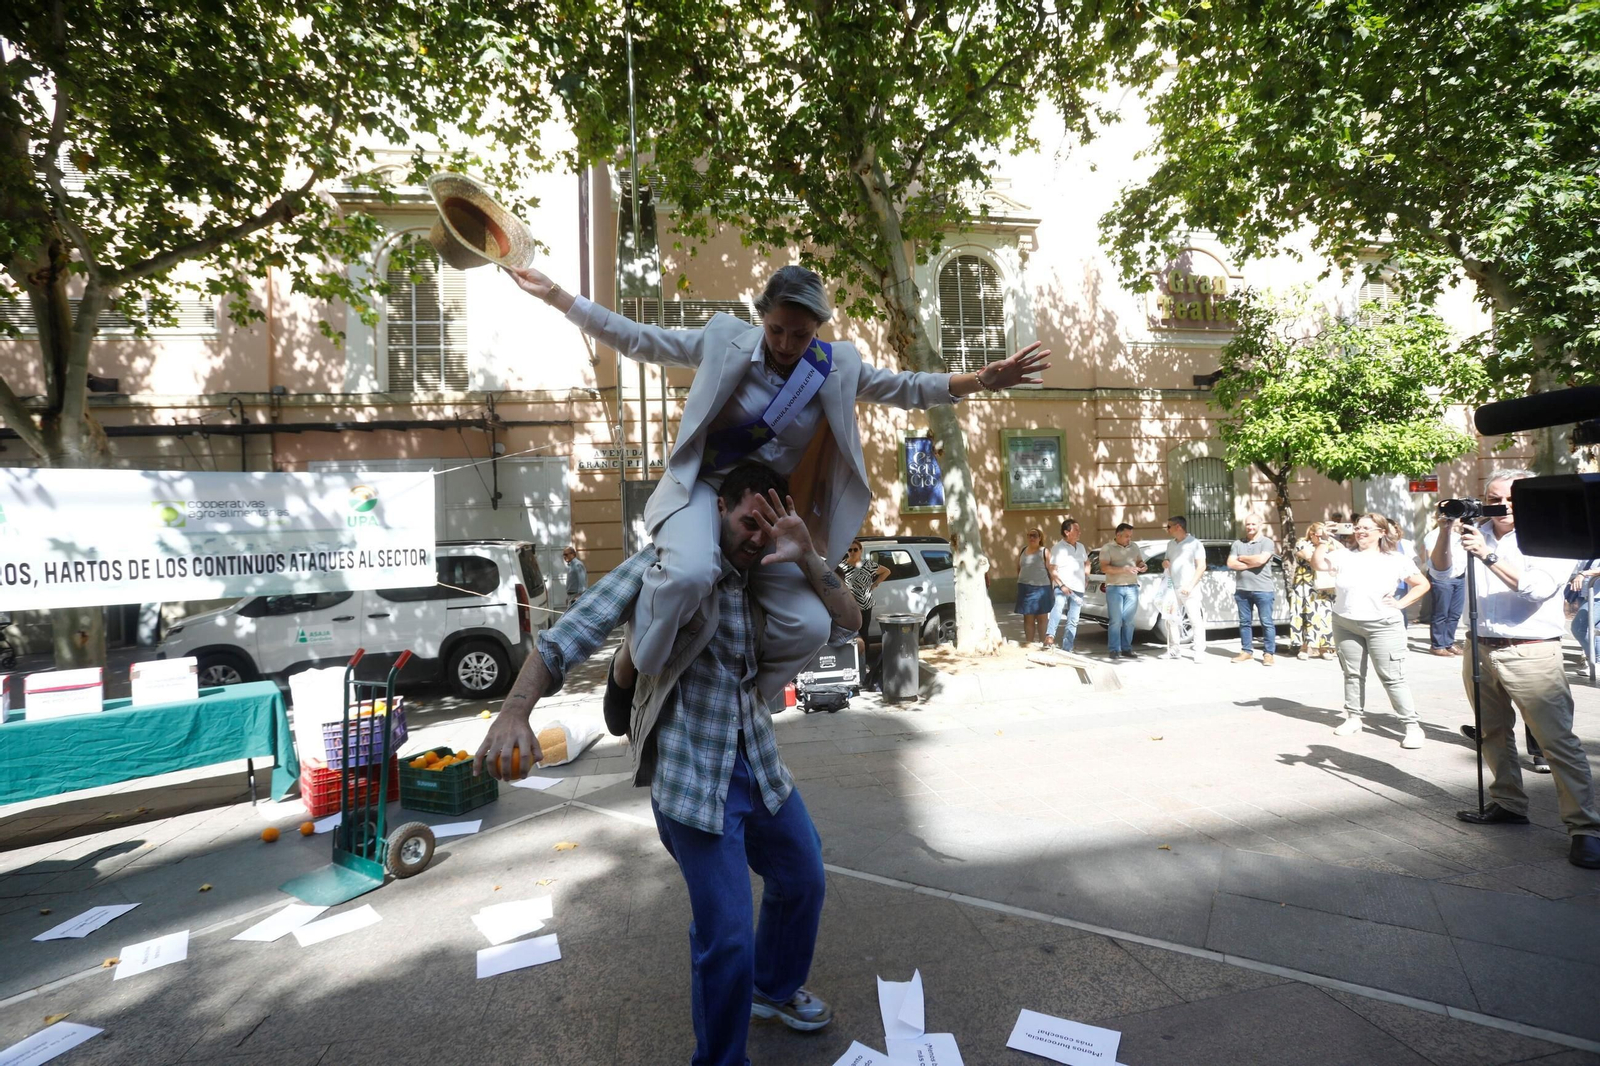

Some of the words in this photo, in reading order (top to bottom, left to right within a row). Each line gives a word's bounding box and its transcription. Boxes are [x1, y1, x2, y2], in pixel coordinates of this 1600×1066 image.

[1168, 270, 1227, 295] Gran
[771, 408, 790, 427] URSULA
[787, 395, 797, 408] VON
[796, 384, 805, 396] DER
[804, 369, 815, 386] LEYEN
[578, 460, 608, 469] GRAN
[188, 500, 265, 510] cooperativas
[347, 515, 379, 527] UPA
[0, 562, 38, 588] OS,
[45, 560, 123, 584] HARTOS
[128, 559, 150, 580] DE
[156, 557, 187, 578] LOS
[193, 554, 285, 577] CONTINUOS
[290, 550, 354, 572] ATAQUES
[359, 550, 374, 568] AL
[378, 549, 427, 567] SECTOR
[1025, 1033, 1071, 1049] burocracia,
[1038, 1029, 1074, 1042] cosecha!
[1072, 1046, 1103, 1058] ¡Menos
